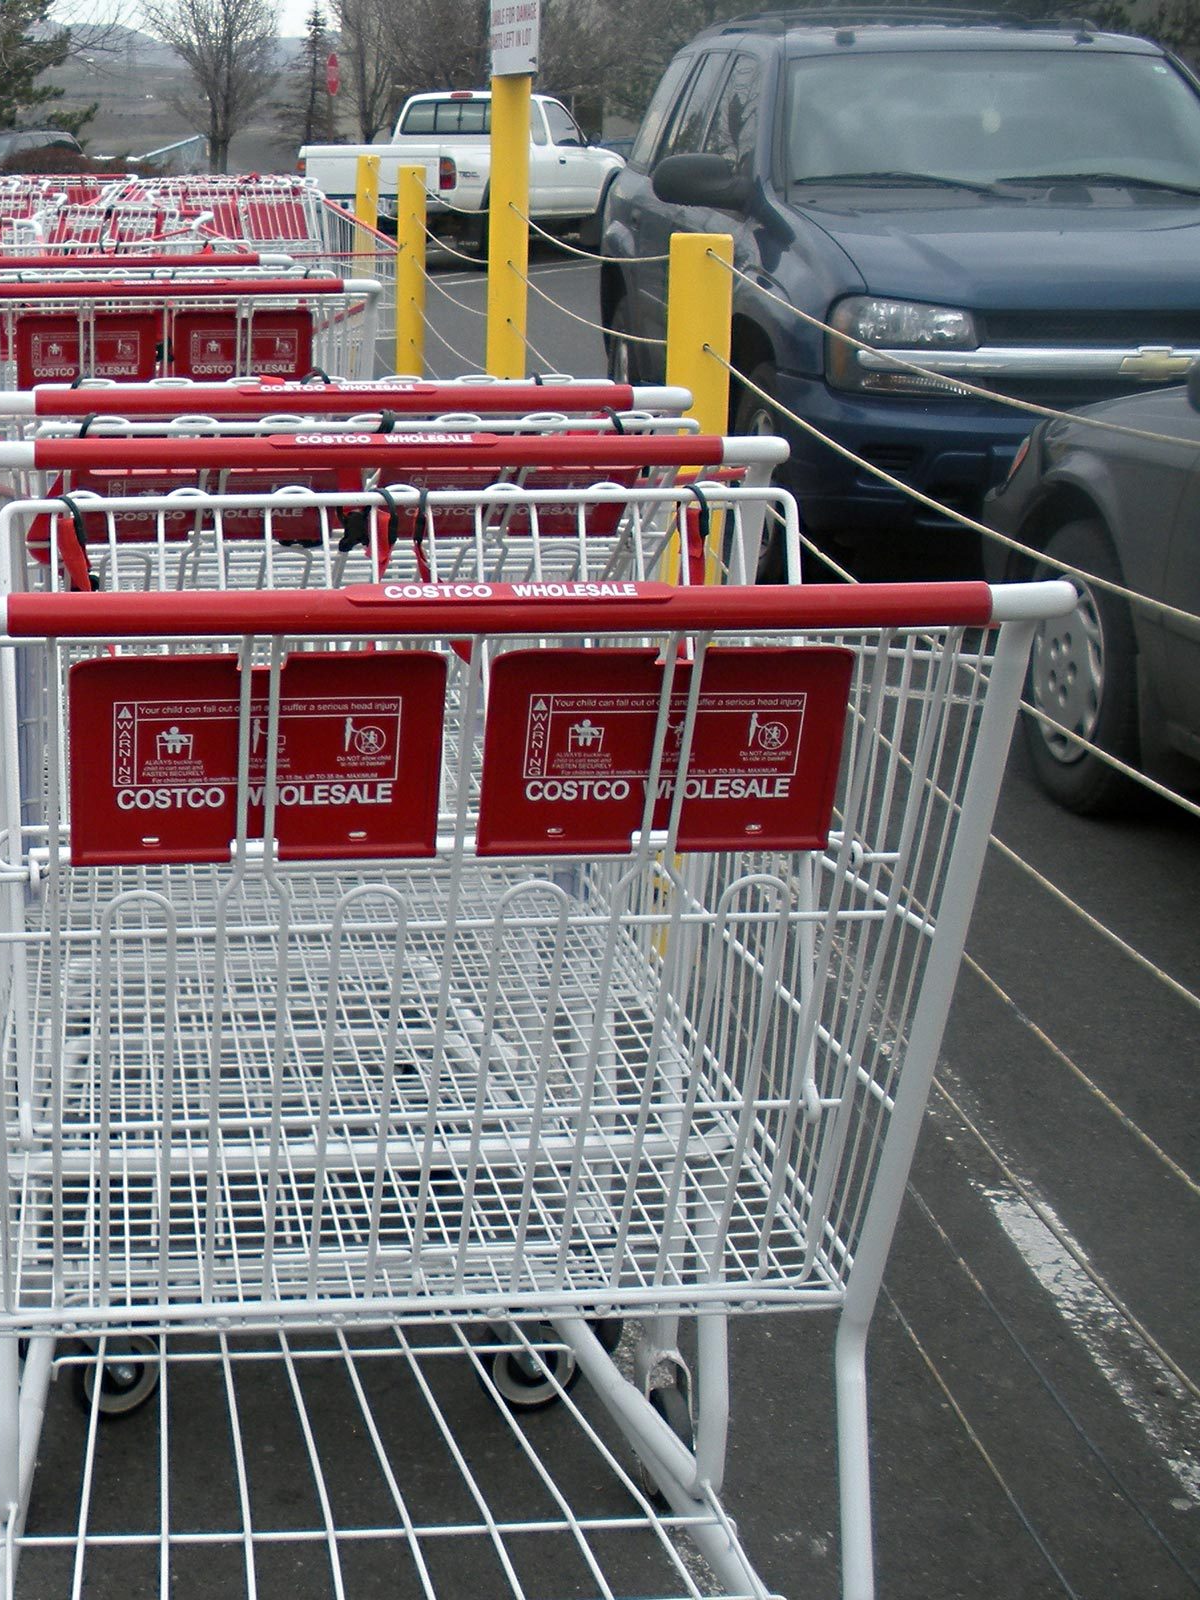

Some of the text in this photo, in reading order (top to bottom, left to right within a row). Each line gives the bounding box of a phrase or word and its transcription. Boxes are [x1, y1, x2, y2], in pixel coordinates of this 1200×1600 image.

[33, 367, 75, 378] COSTCO
[191, 364, 233, 375] COSTCO
[260, 383, 415, 392] COSTCO WHOLESALE
[295, 433, 473, 444] COSTCO WHOLESALE
[383, 583, 639, 599] COSTCO WHOLESALE
[282, 703, 306, 711] suffer
[351, 702, 373, 710] head
[374, 702, 398, 711] injury
[554, 699, 574, 707] Your
[576, 698, 596, 707] child
[757, 698, 778, 706] head
[779, 698, 802, 708] injury
[139, 706, 160, 714] Your
[161, 705, 182, 713] child
[203, 705, 216, 713] fall
[218, 705, 233, 713] out
[528, 712, 549, 776] WARNING
[116, 720, 134, 785] WARNING
[525, 779, 630, 802] COSTCO
[116, 786, 225, 811] COSTCO
